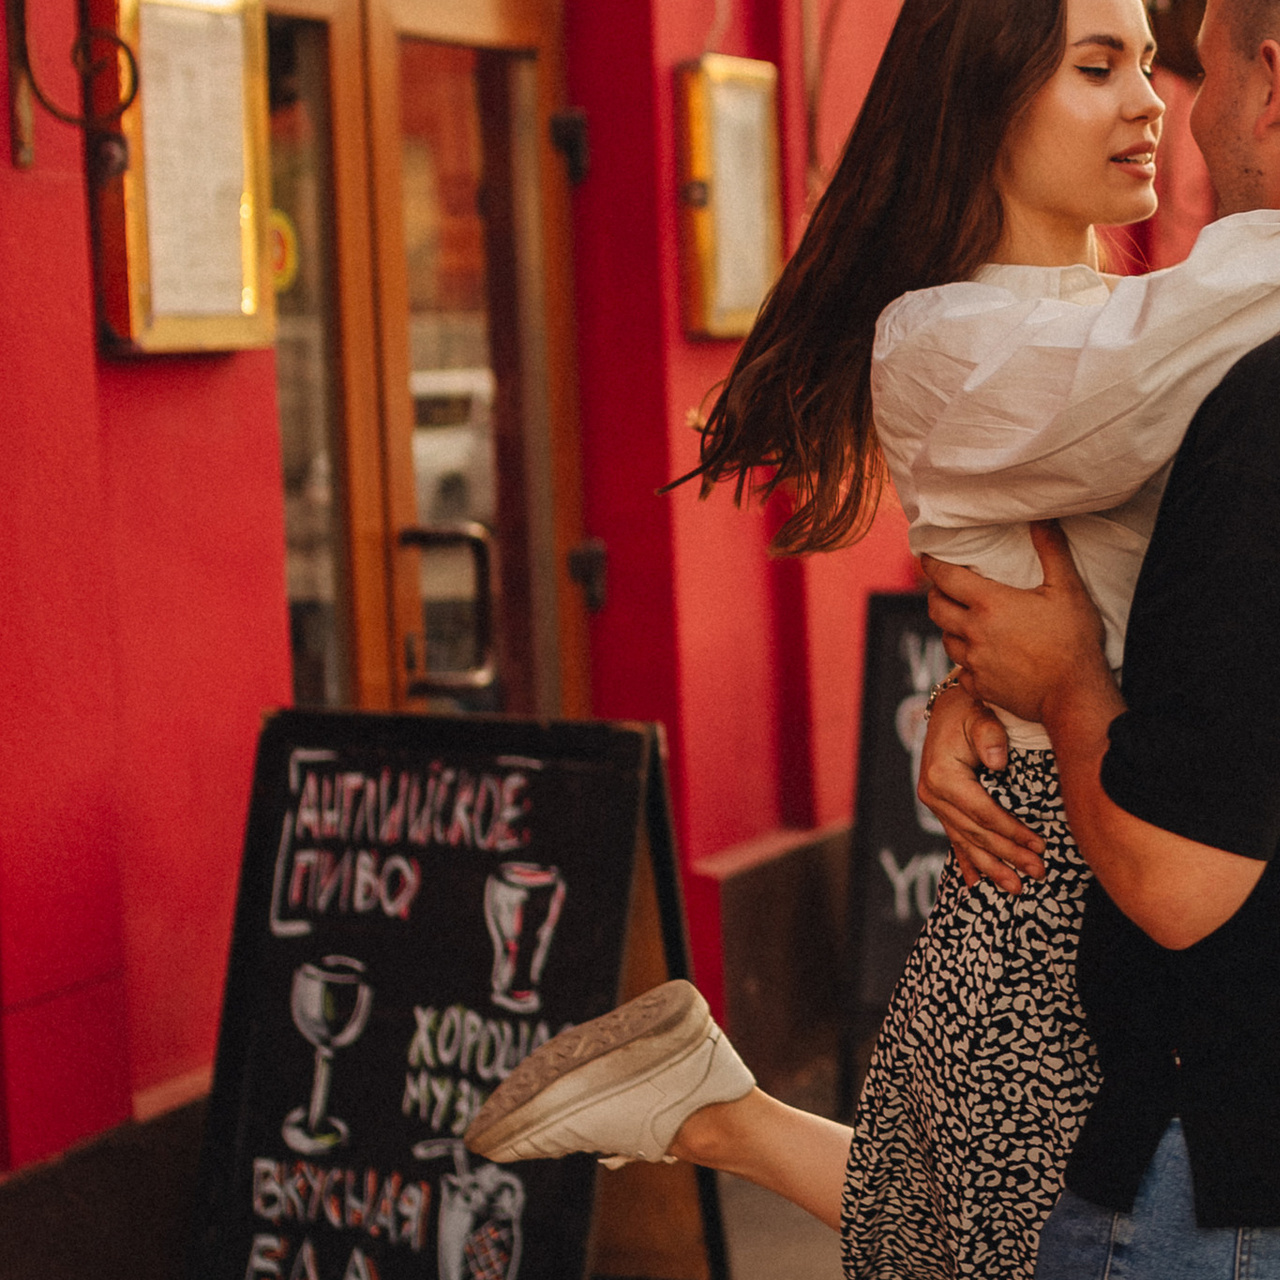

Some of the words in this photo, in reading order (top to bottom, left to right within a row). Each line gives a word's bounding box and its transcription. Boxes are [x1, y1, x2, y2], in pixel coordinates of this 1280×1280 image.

[296, 760, 532, 851] АНГЛИЙСКОЕ
[288, 848, 421, 920] ПИВО
[253, 1156, 431, 1253] ВКУСНАЯ
